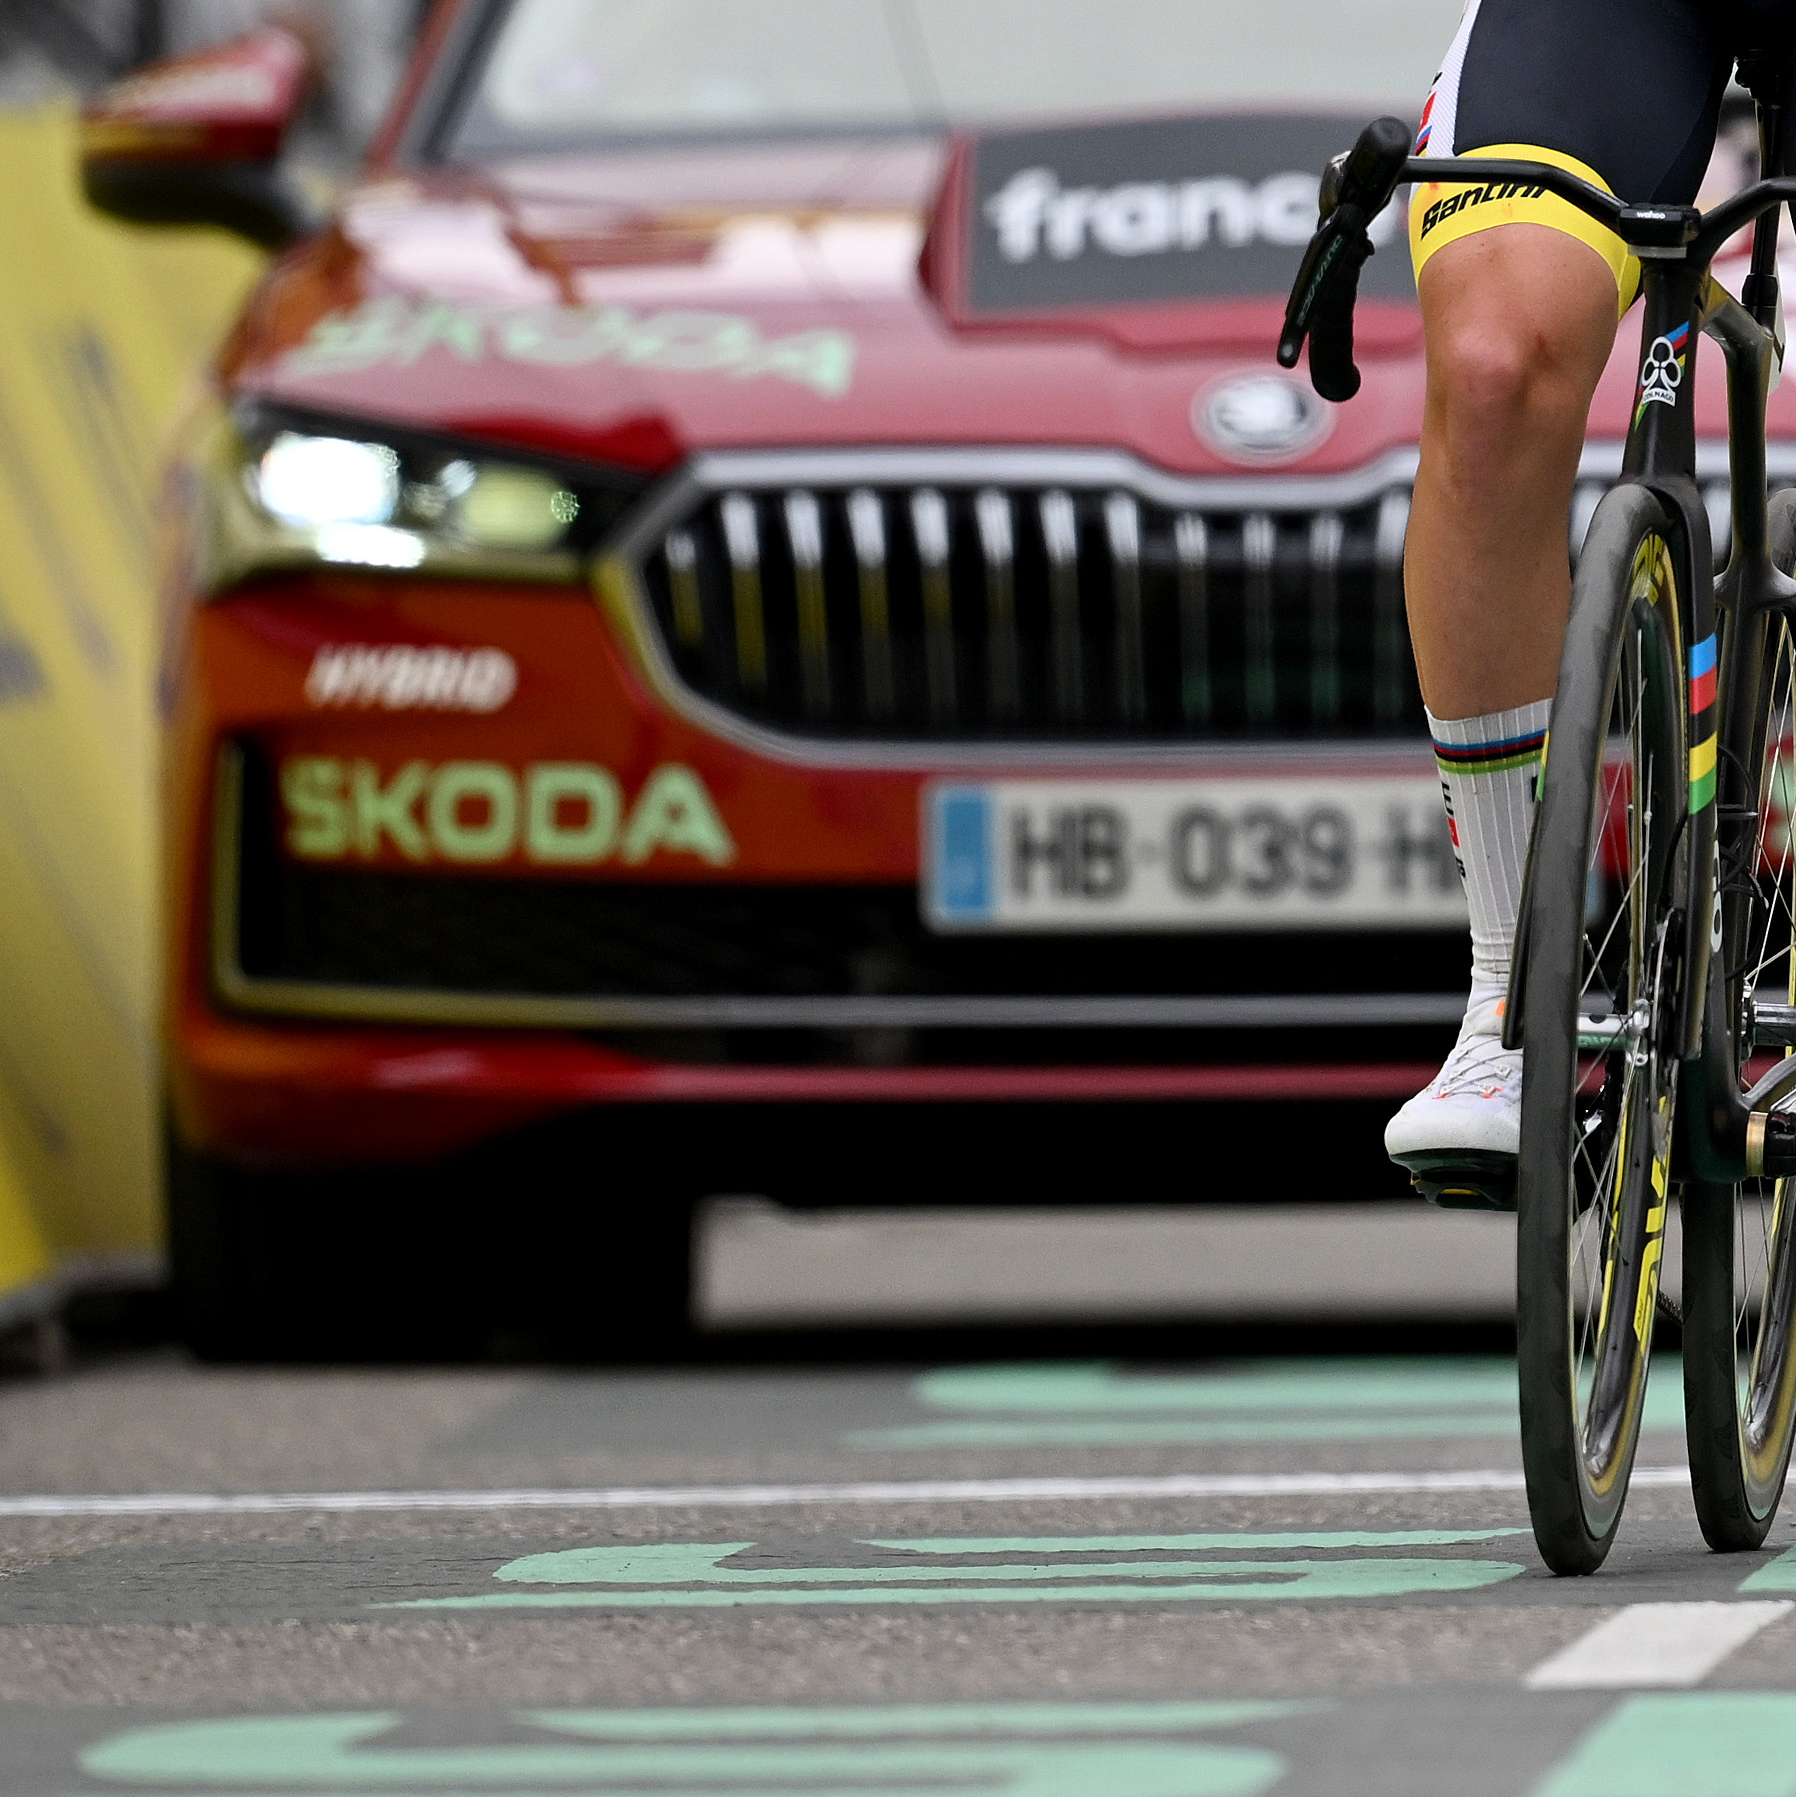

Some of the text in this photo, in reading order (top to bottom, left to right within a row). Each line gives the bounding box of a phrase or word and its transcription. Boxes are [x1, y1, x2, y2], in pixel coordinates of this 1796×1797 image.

[983, 167, 1396, 264] franc
[1636, 210, 1666, 220] wahoo
[306, 646, 520, 712] HYBRID
